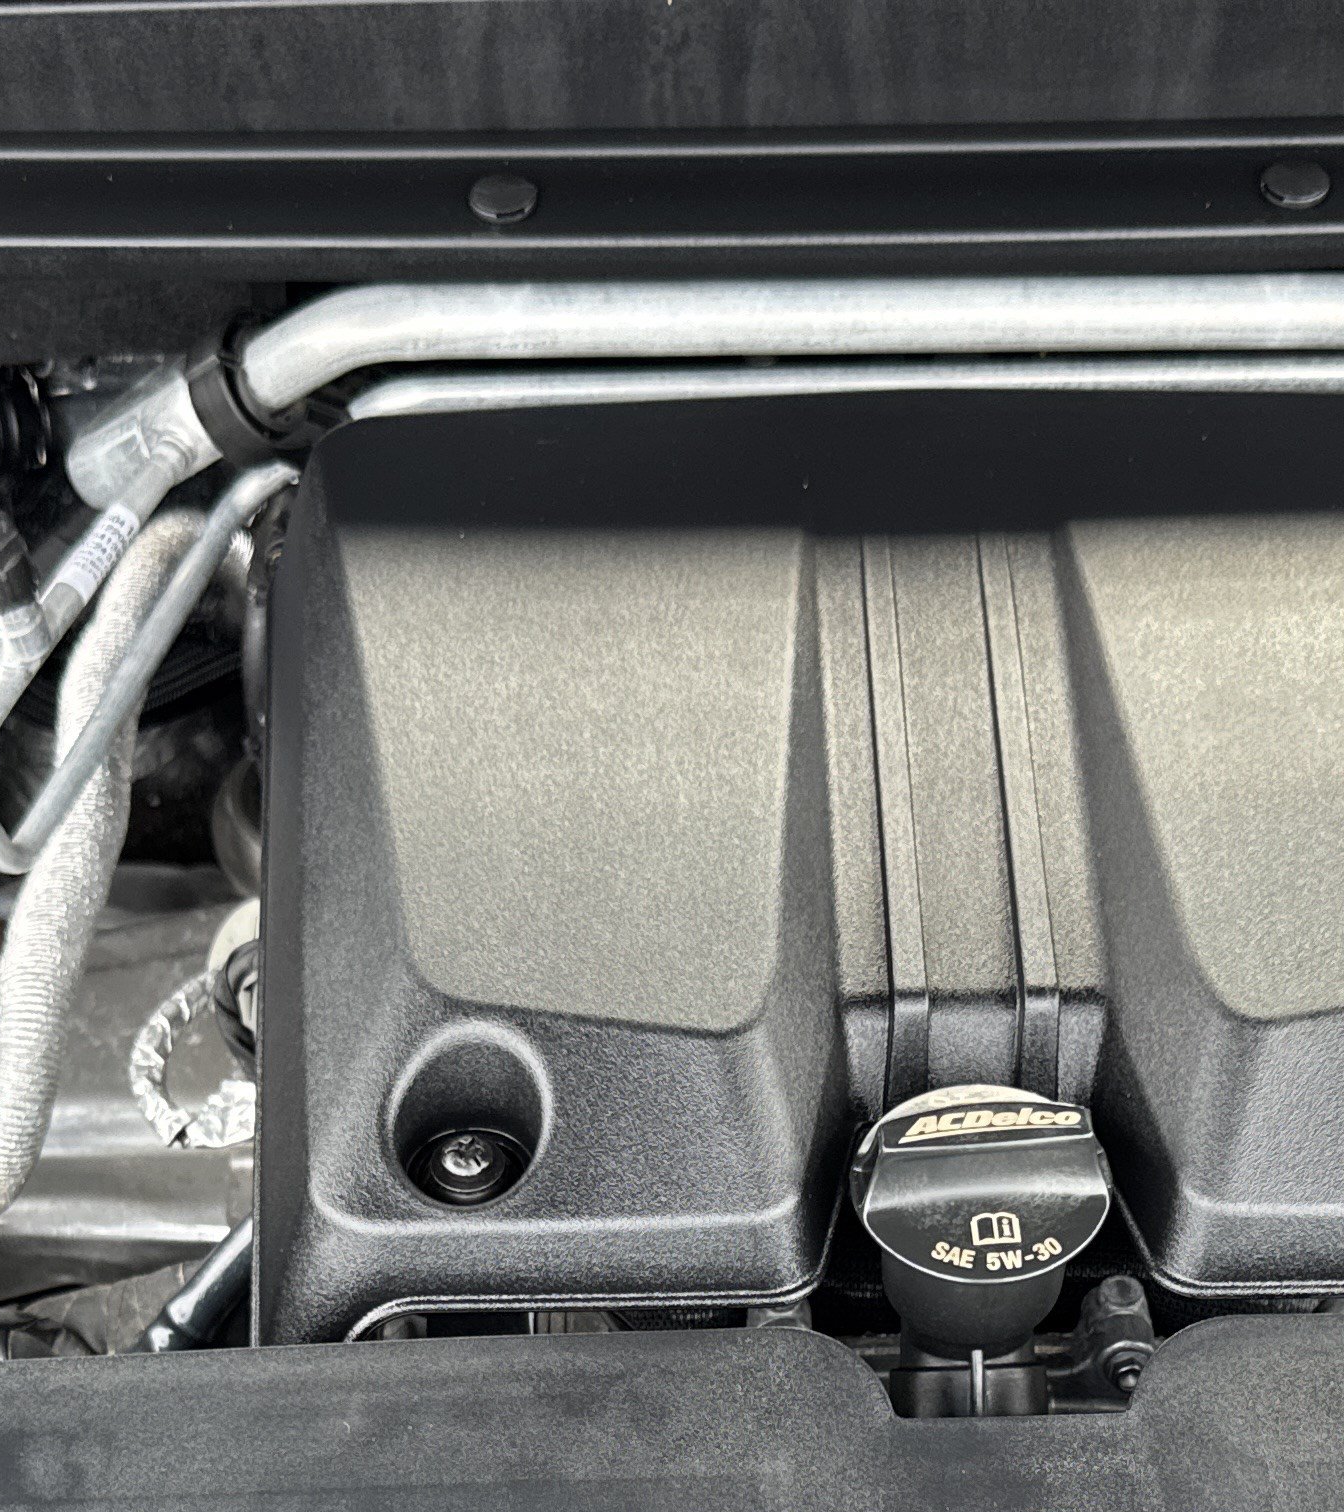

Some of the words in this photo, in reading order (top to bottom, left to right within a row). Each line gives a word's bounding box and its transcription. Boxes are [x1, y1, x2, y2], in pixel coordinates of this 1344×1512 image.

[905, 1107, 1082, 1137] ACDelco
[930, 1241, 976, 1269] SAE
[986, 1236, 1063, 1271] 5W-30
